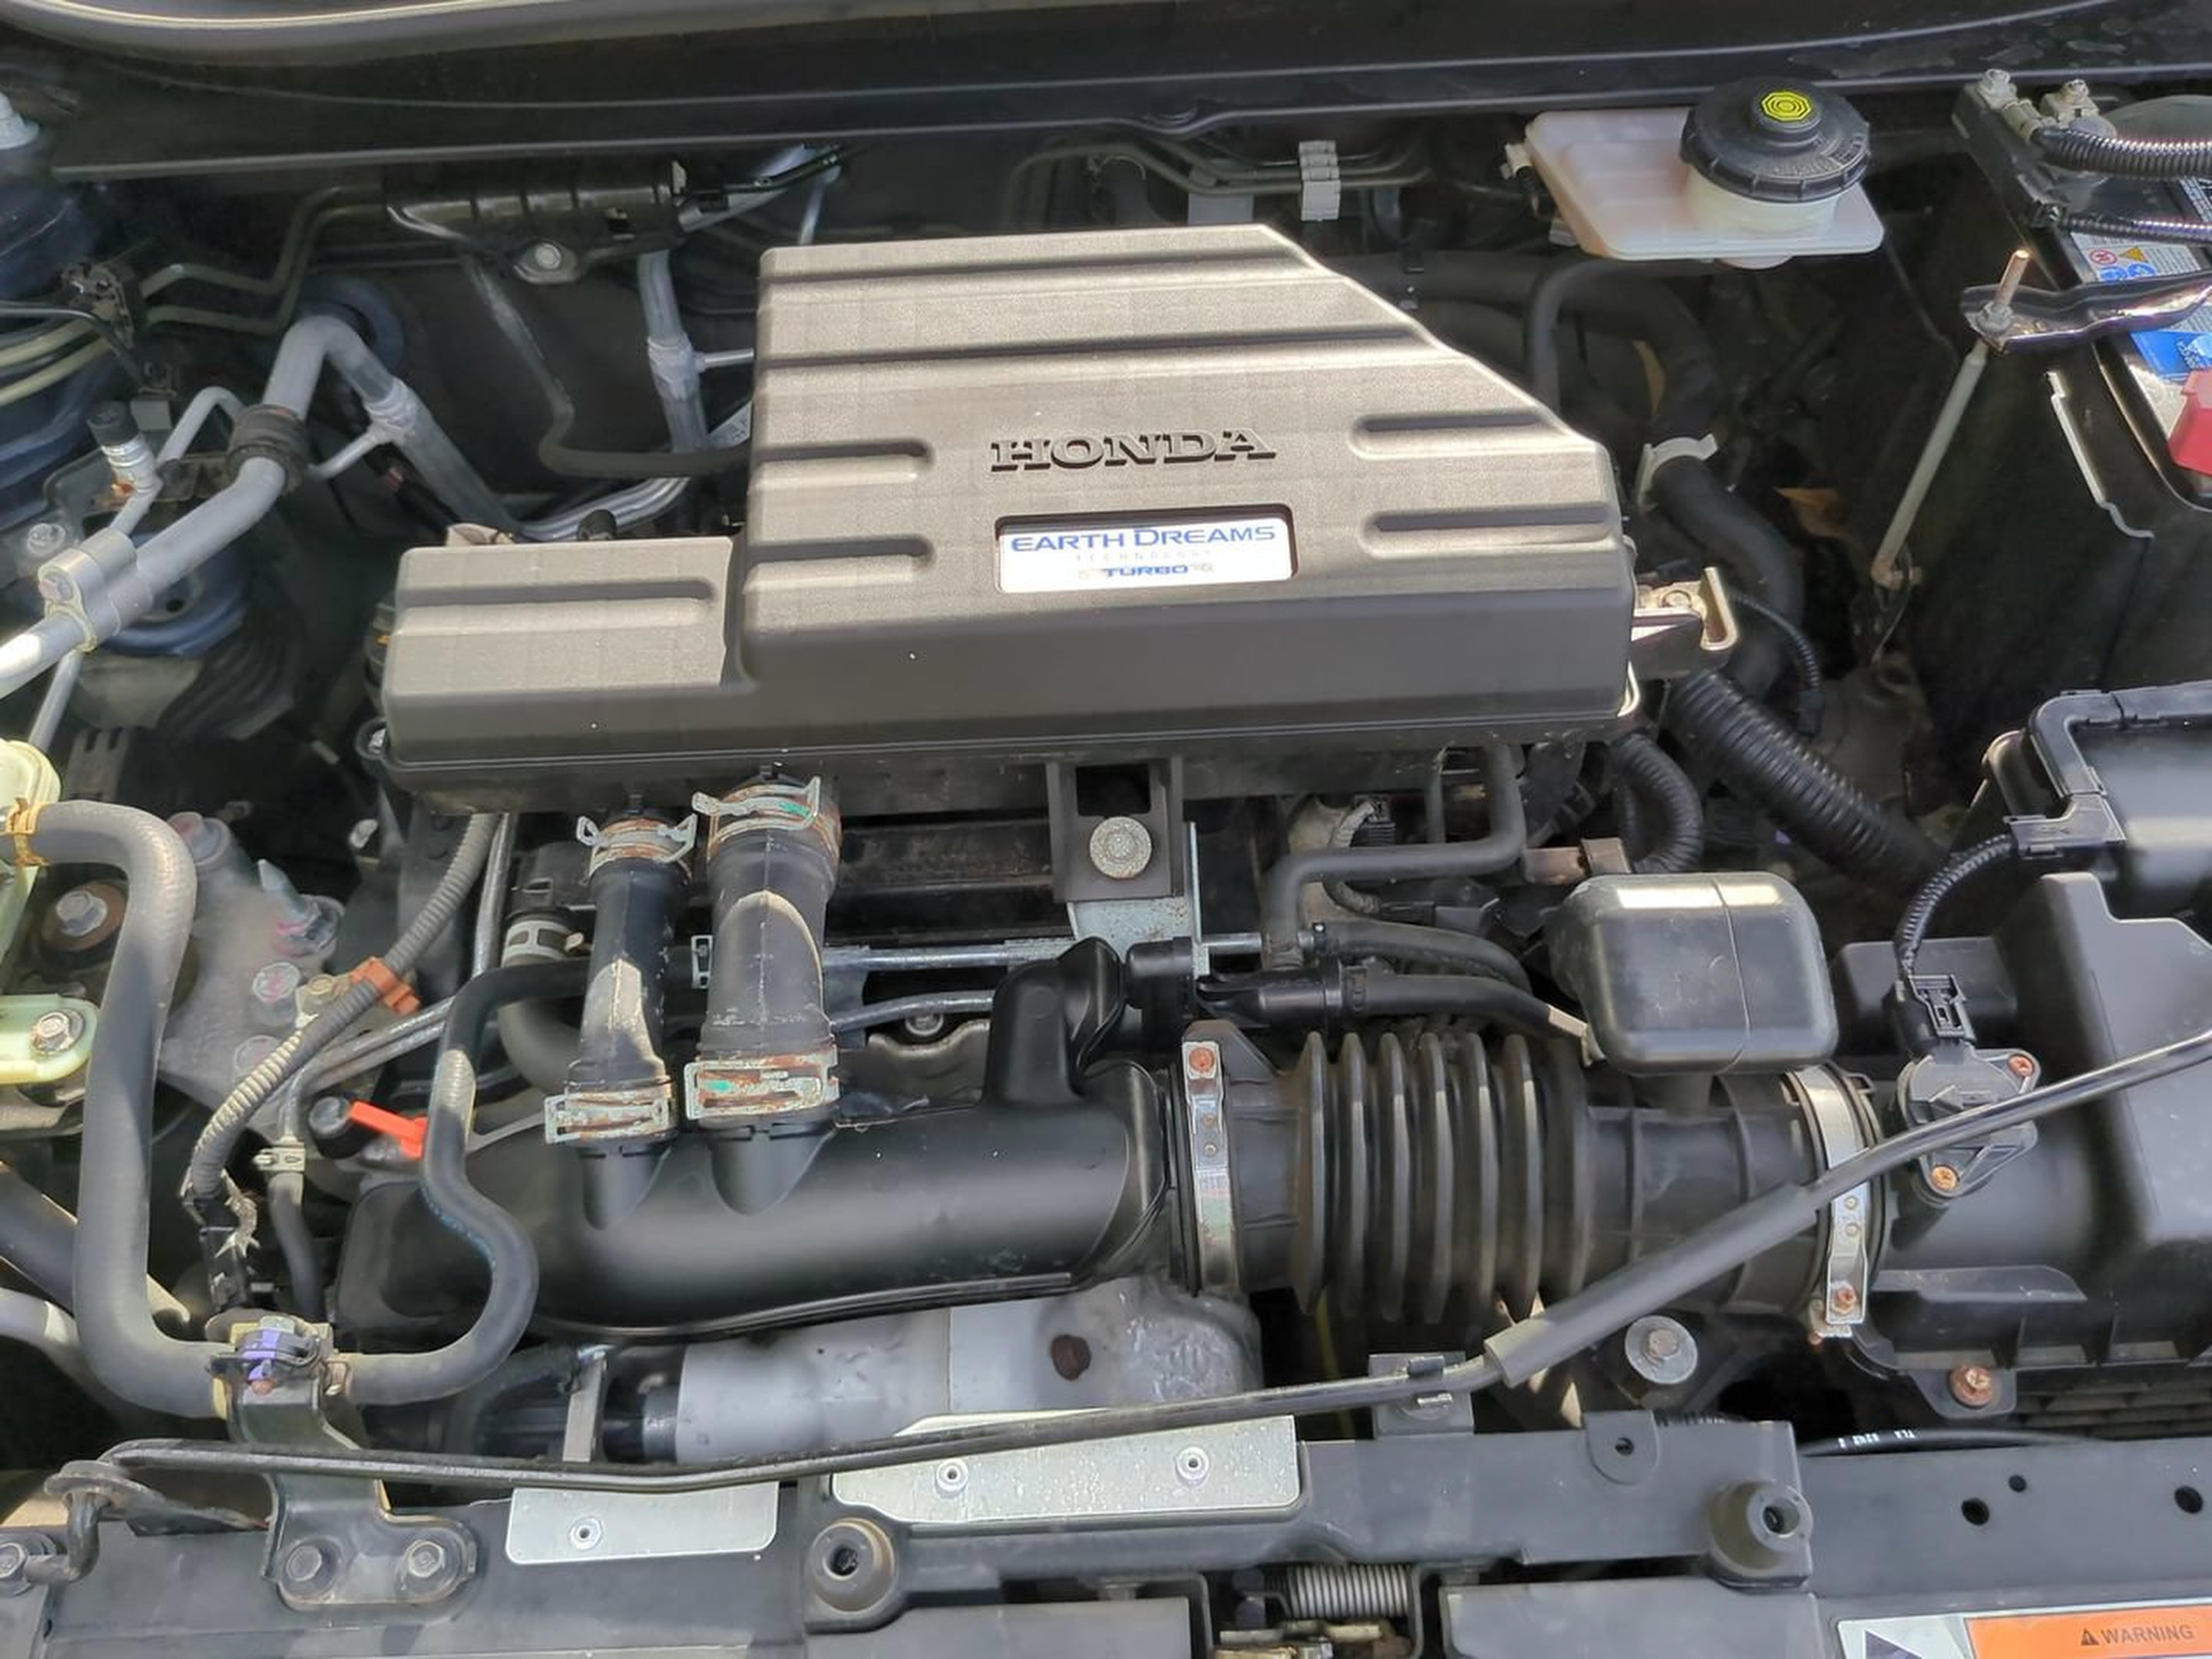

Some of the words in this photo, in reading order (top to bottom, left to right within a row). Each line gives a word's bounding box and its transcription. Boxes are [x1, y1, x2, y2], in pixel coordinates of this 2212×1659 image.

[991, 429, 1277, 472] HONDA
[1012, 534, 1124, 551] EARTH
[1134, 527, 1276, 546] DREAMS
[1104, 565, 1188, 577] TURBO
[2101, 1624, 2194, 1644] WARNING
